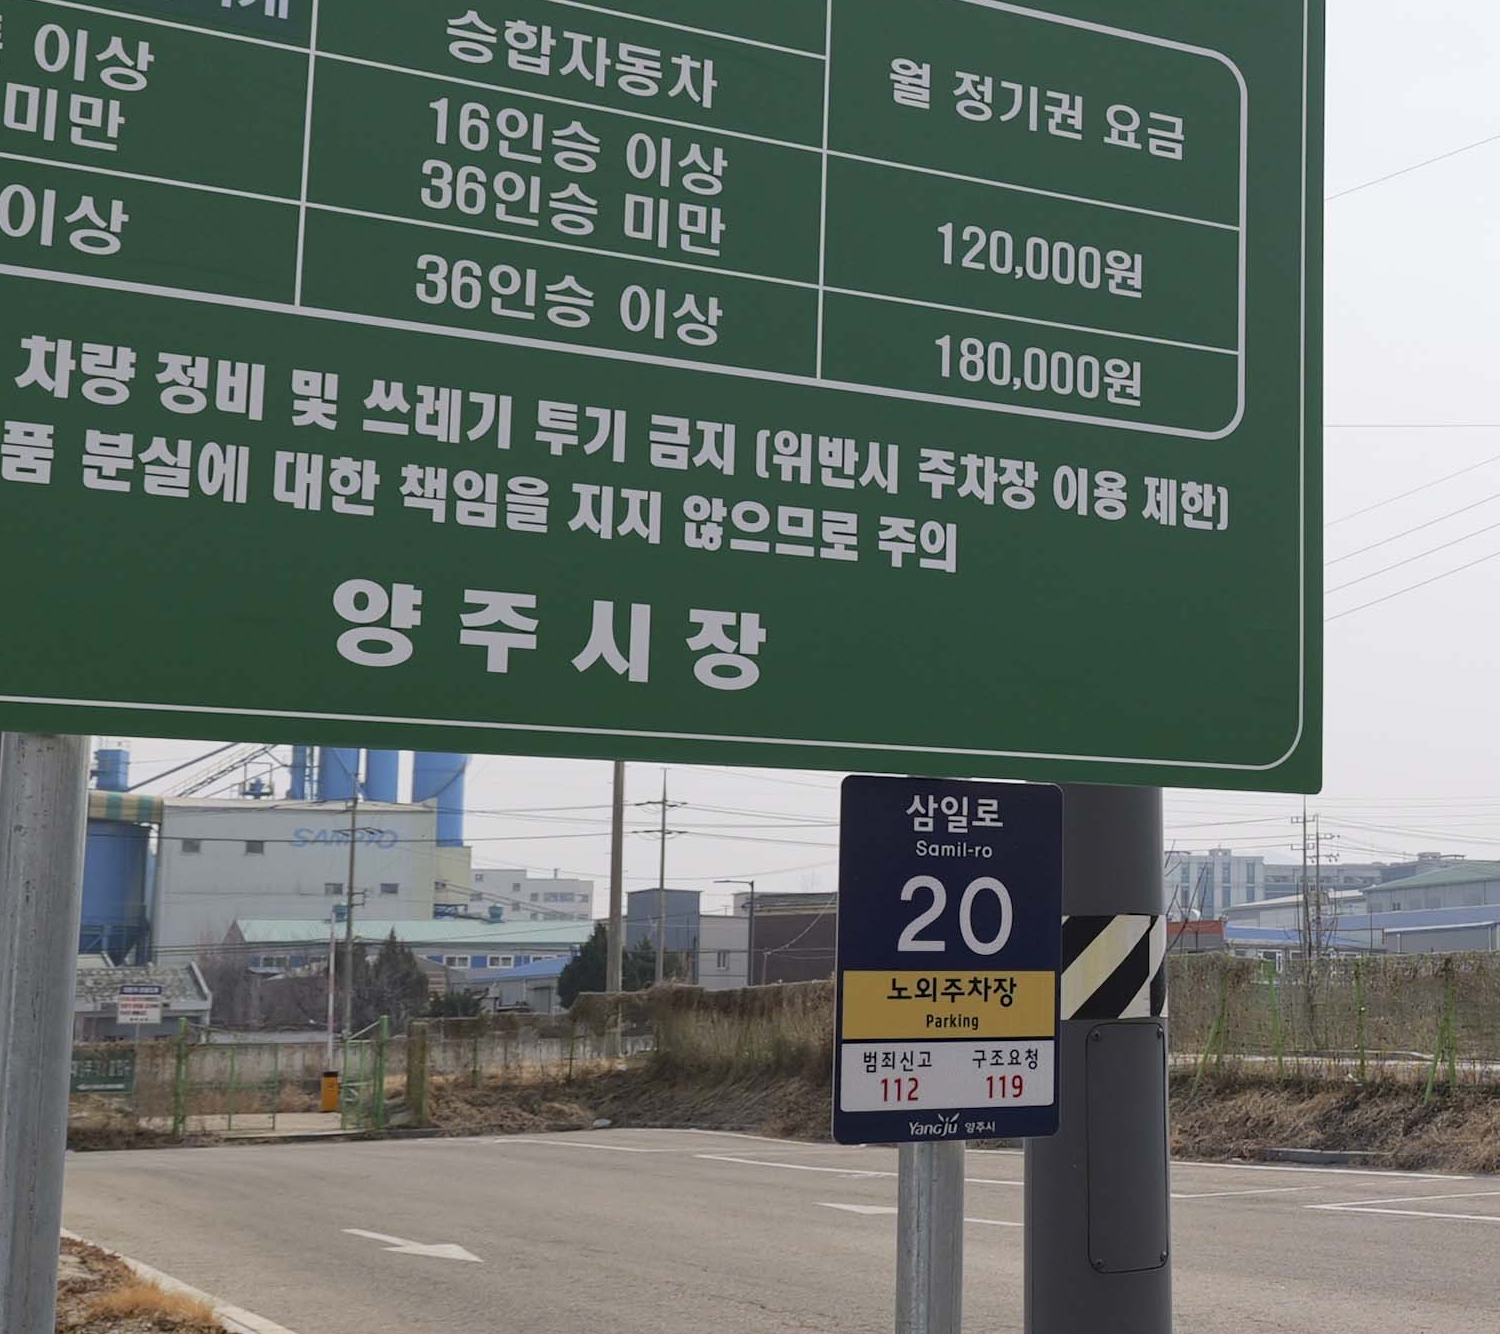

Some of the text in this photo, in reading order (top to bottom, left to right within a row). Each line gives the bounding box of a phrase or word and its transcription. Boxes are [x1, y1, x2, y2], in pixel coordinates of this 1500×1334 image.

[34, 23, 155, 92] 이상
[446, 9, 718, 109] 승합자동차
[3, 82, 126, 152] 미만
[889, 58, 1185, 161] 월 정기권 요금
[429, 97, 728, 196] 16인승 이상
[420, 159, 726, 257] 36인승 미만
[937, 222, 1143, 299] 120,000원
[415, 254, 723, 346] 36인승 이상
[935, 334, 1141, 407] 180,000원
[14, 334, 137, 405] 차량
[155, 352, 266, 421] 정비
[291, 369, 339, 431] 및
[362, 379, 513, 450] 쓰레기
[535, 400, 627, 463] 투기
[649, 414, 736, 476] 금지
[918, 448, 1039, 510] 주차장
[1053, 465, 1128, 521] 이용
[82, 429, 250, 504] 분실에
[273, 450, 381, 516] 대한
[399, 463, 550, 533] 책임을
[567, 483, 662, 545] 지지
[682, 495, 859, 562] 않으므로
[878, 516, 957, 573] 주의
[905, 794, 1004, 834] 삼일로
[915, 839, 993, 858] Samil-ro
[896, 874, 1014, 956] 20
[886, 976, 1018, 1007] 노외주차장
[925, 1013, 979, 1030] Parking
[862, 1048, 1040, 1073] 범죄신고 구조요청
[880, 1074, 1024, 1102] 112 119
[964, 1121, 996, 1134] 양주시
